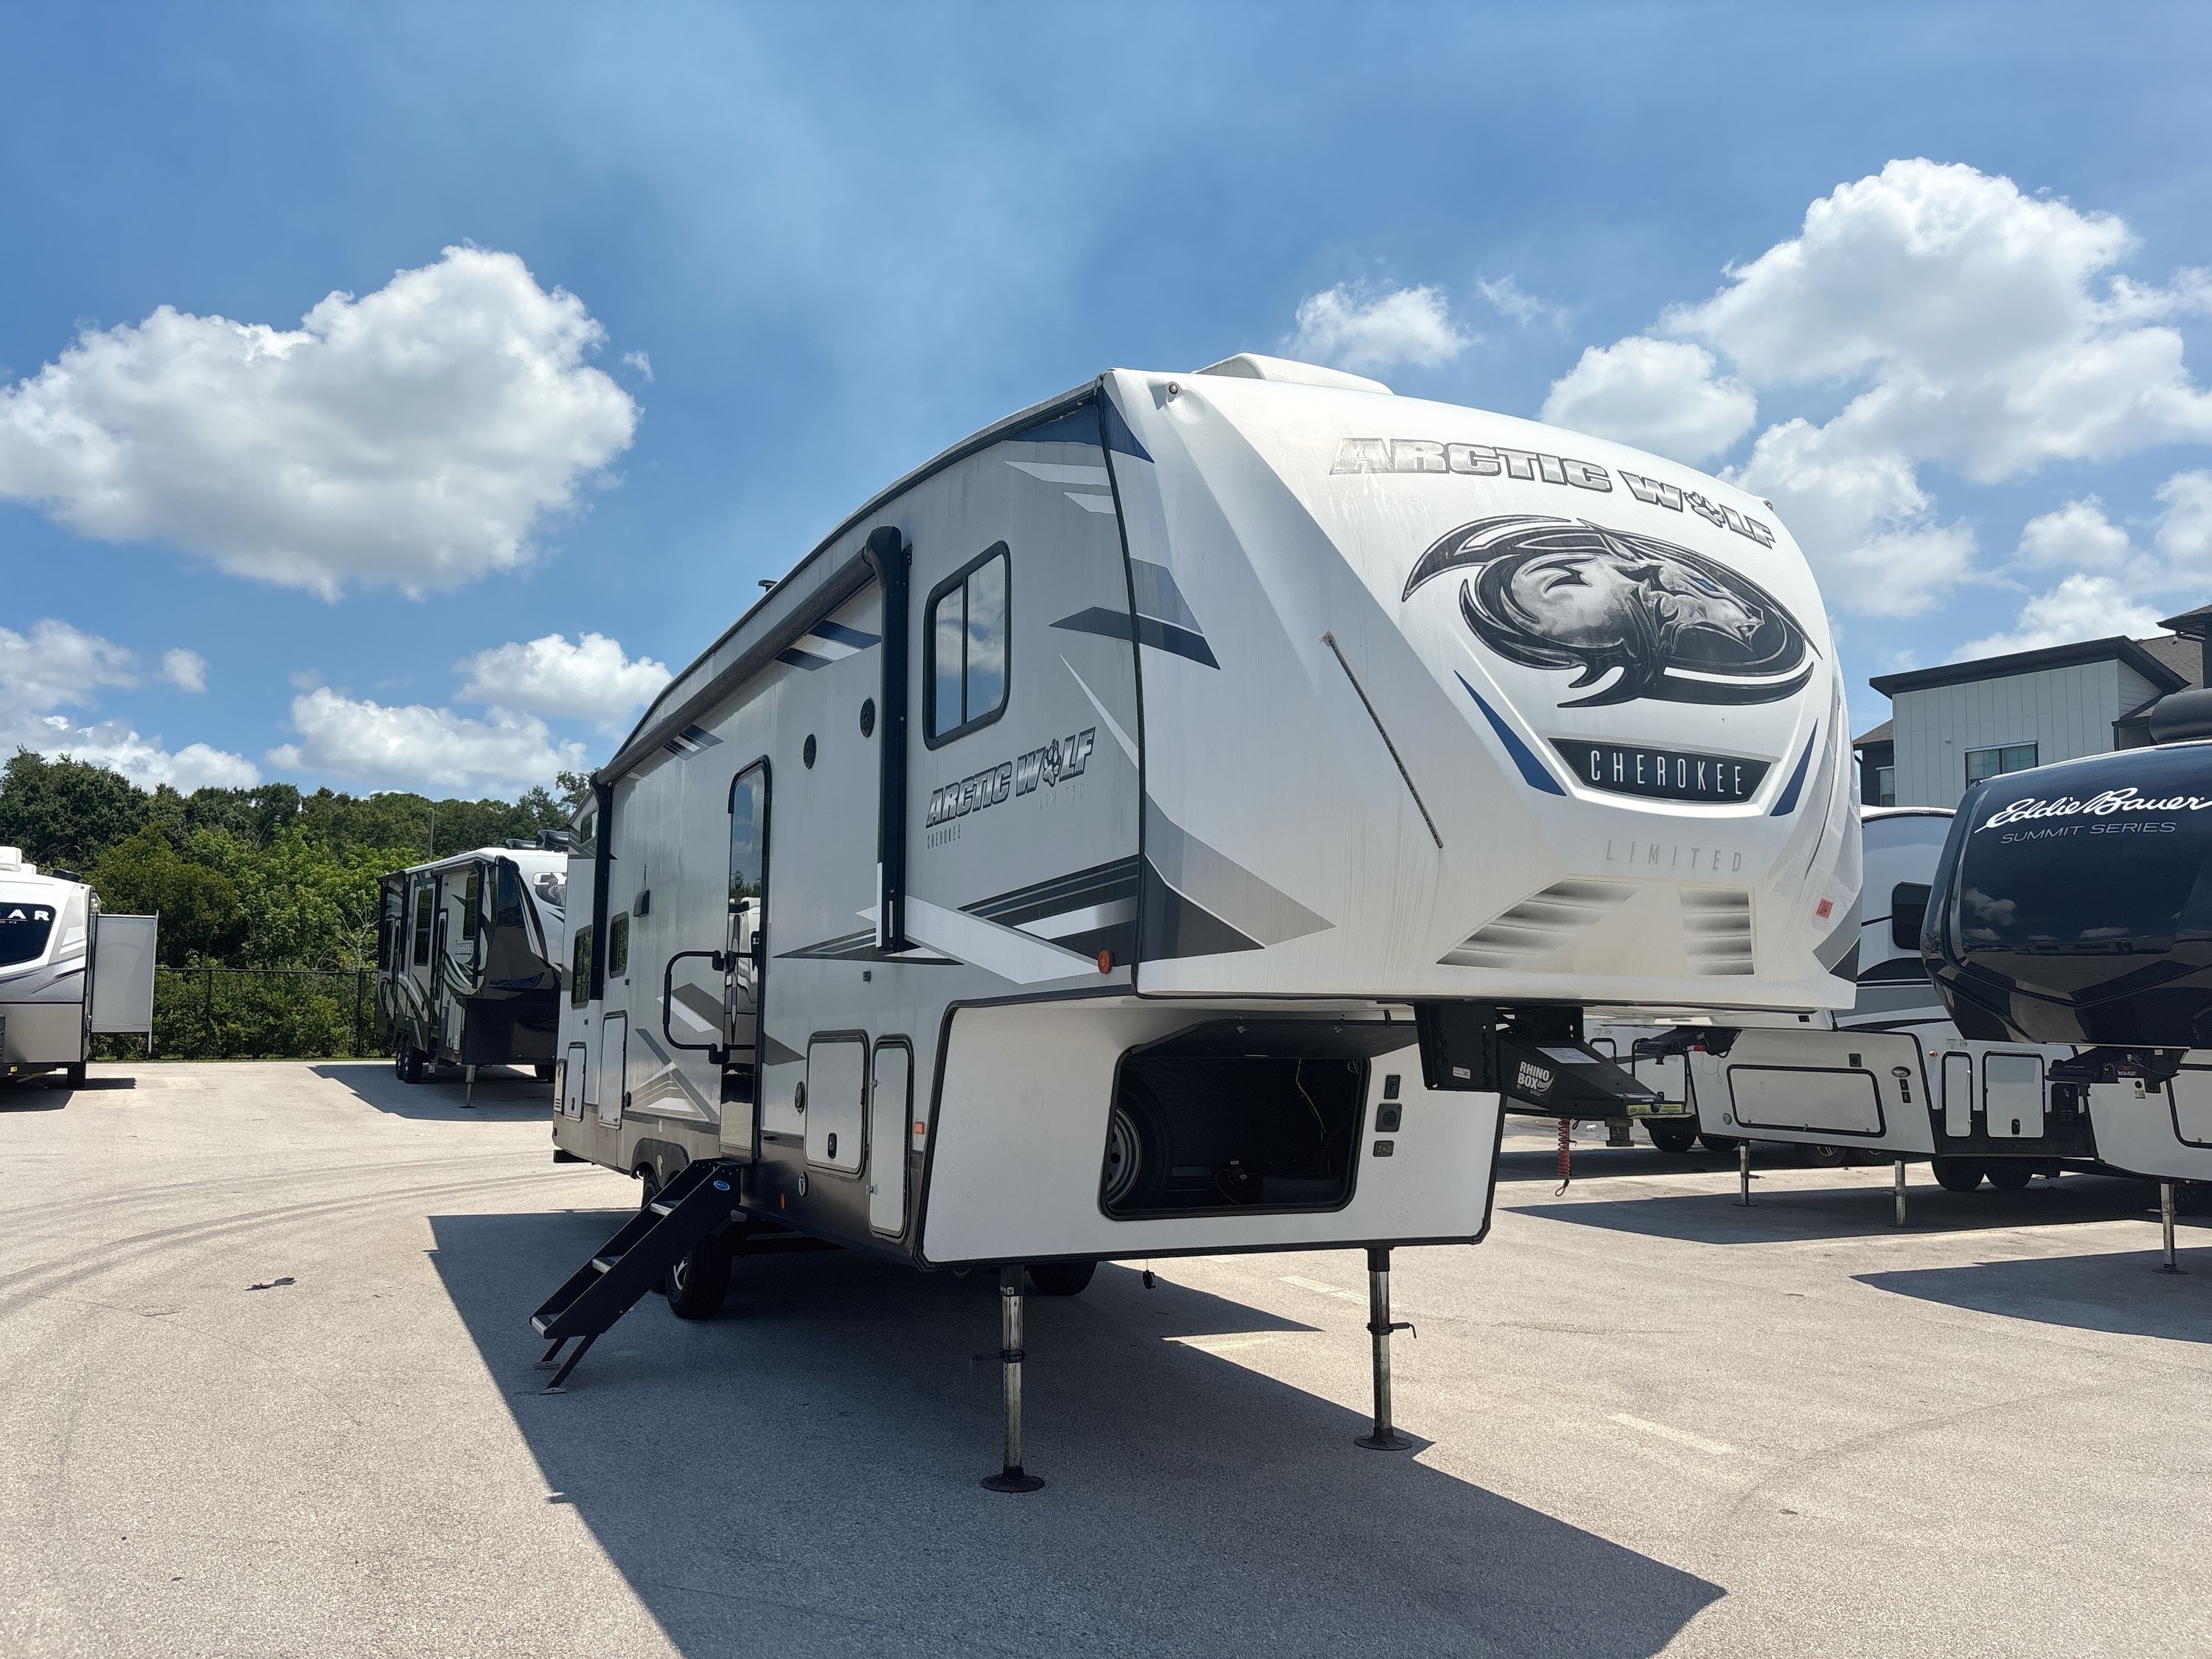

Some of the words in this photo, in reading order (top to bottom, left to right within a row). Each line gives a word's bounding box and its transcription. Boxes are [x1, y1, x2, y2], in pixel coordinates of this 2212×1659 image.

[1329, 437, 1613, 492] ARCTIC
[1590, 750, 1743, 795] CHEROKEE
[925, 760, 1012, 829] ARCTIC
[1039, 782, 1085, 810] LIMITED
[1974, 796, 2083, 834] Eddie
[2082, 787, 2212, 816] Bauer
[927, 824, 961, 849] CHEROKEE
[2000, 825, 2085, 844] SUMMIT
[2089, 821, 2177, 835] SERIES
[1606, 838, 1742, 873] LIMITED
[0, 908, 49, 921] AR
[1517, 1072, 1539, 1090] BOX
[1520, 1061, 1550, 1082] RHINO
